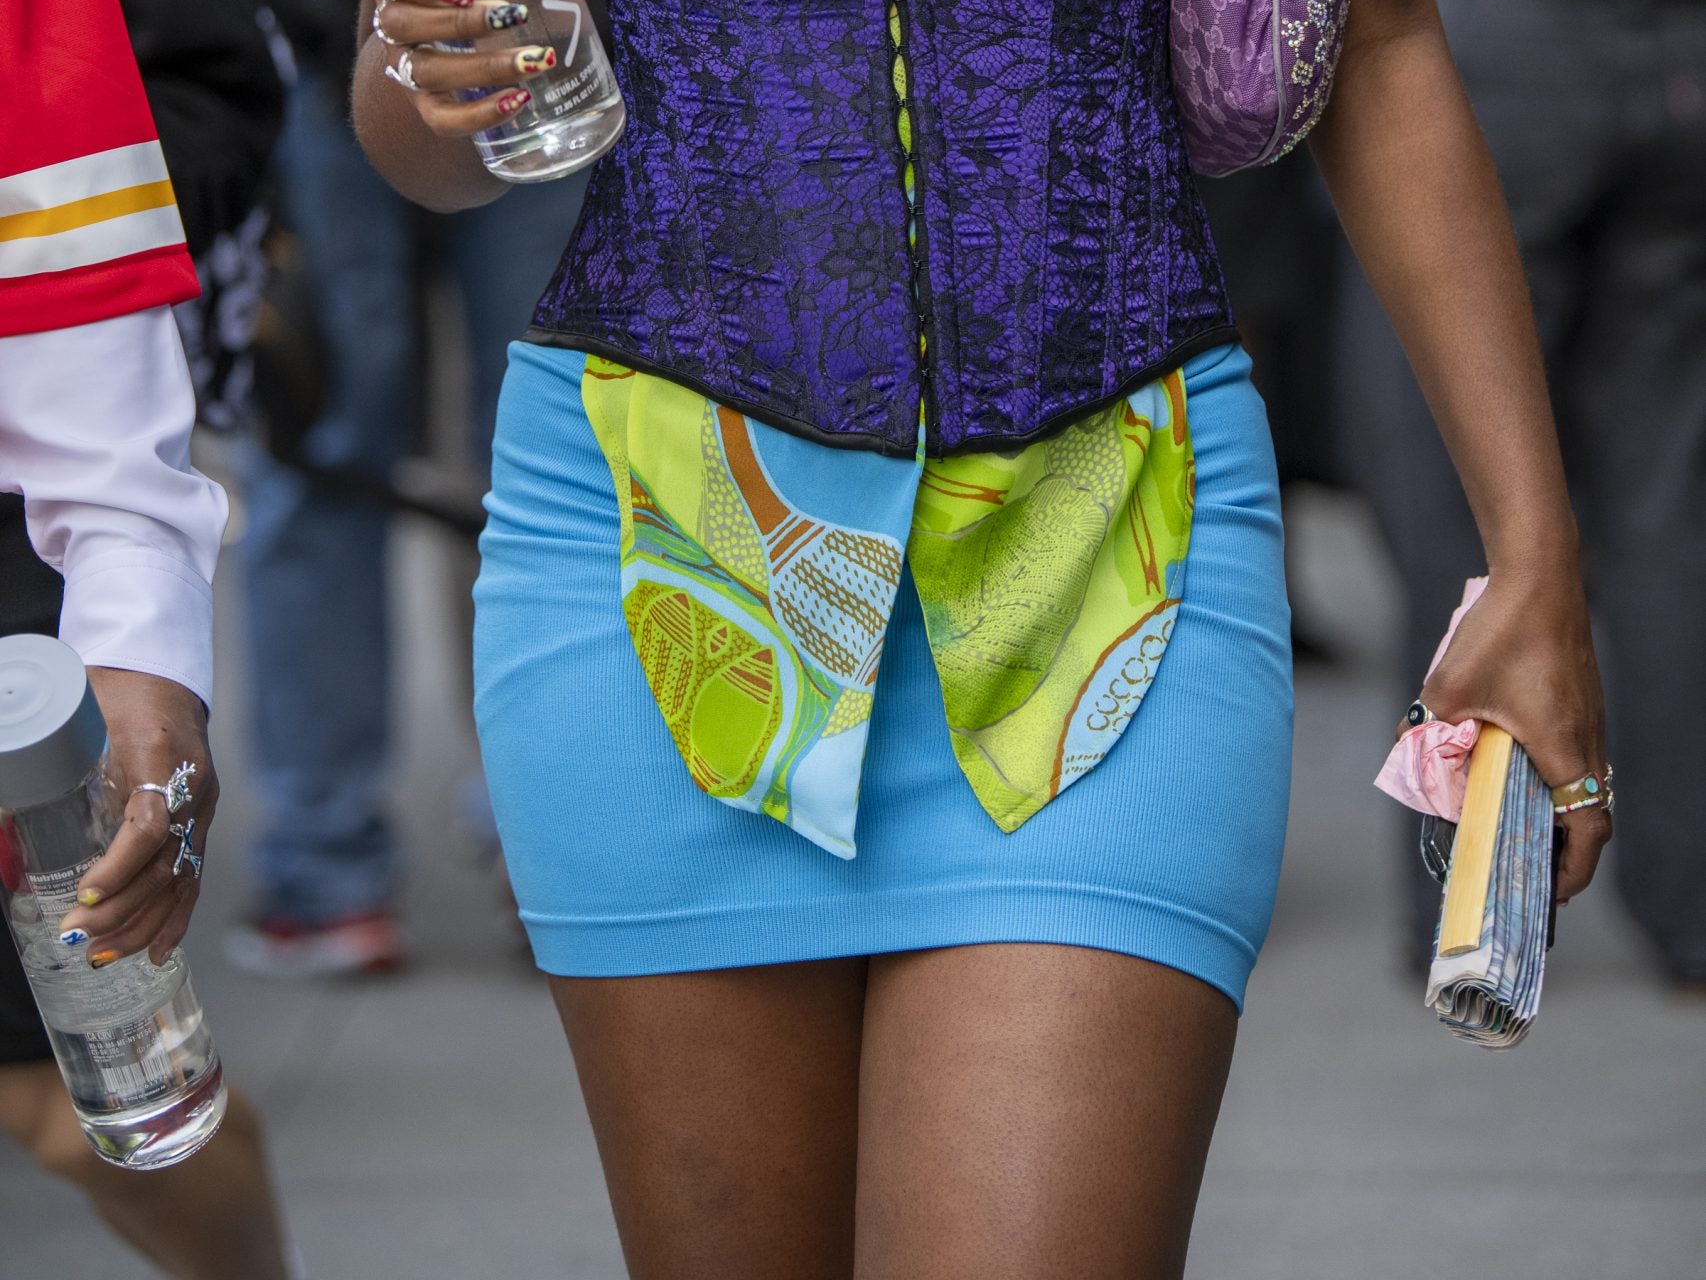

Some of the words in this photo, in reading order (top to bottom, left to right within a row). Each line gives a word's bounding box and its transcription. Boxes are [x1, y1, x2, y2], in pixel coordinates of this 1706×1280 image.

[545, 77, 580, 103] NATURAL
[29, 870, 74, 882] Nutrition
[40, 901, 79, 912] Calories
